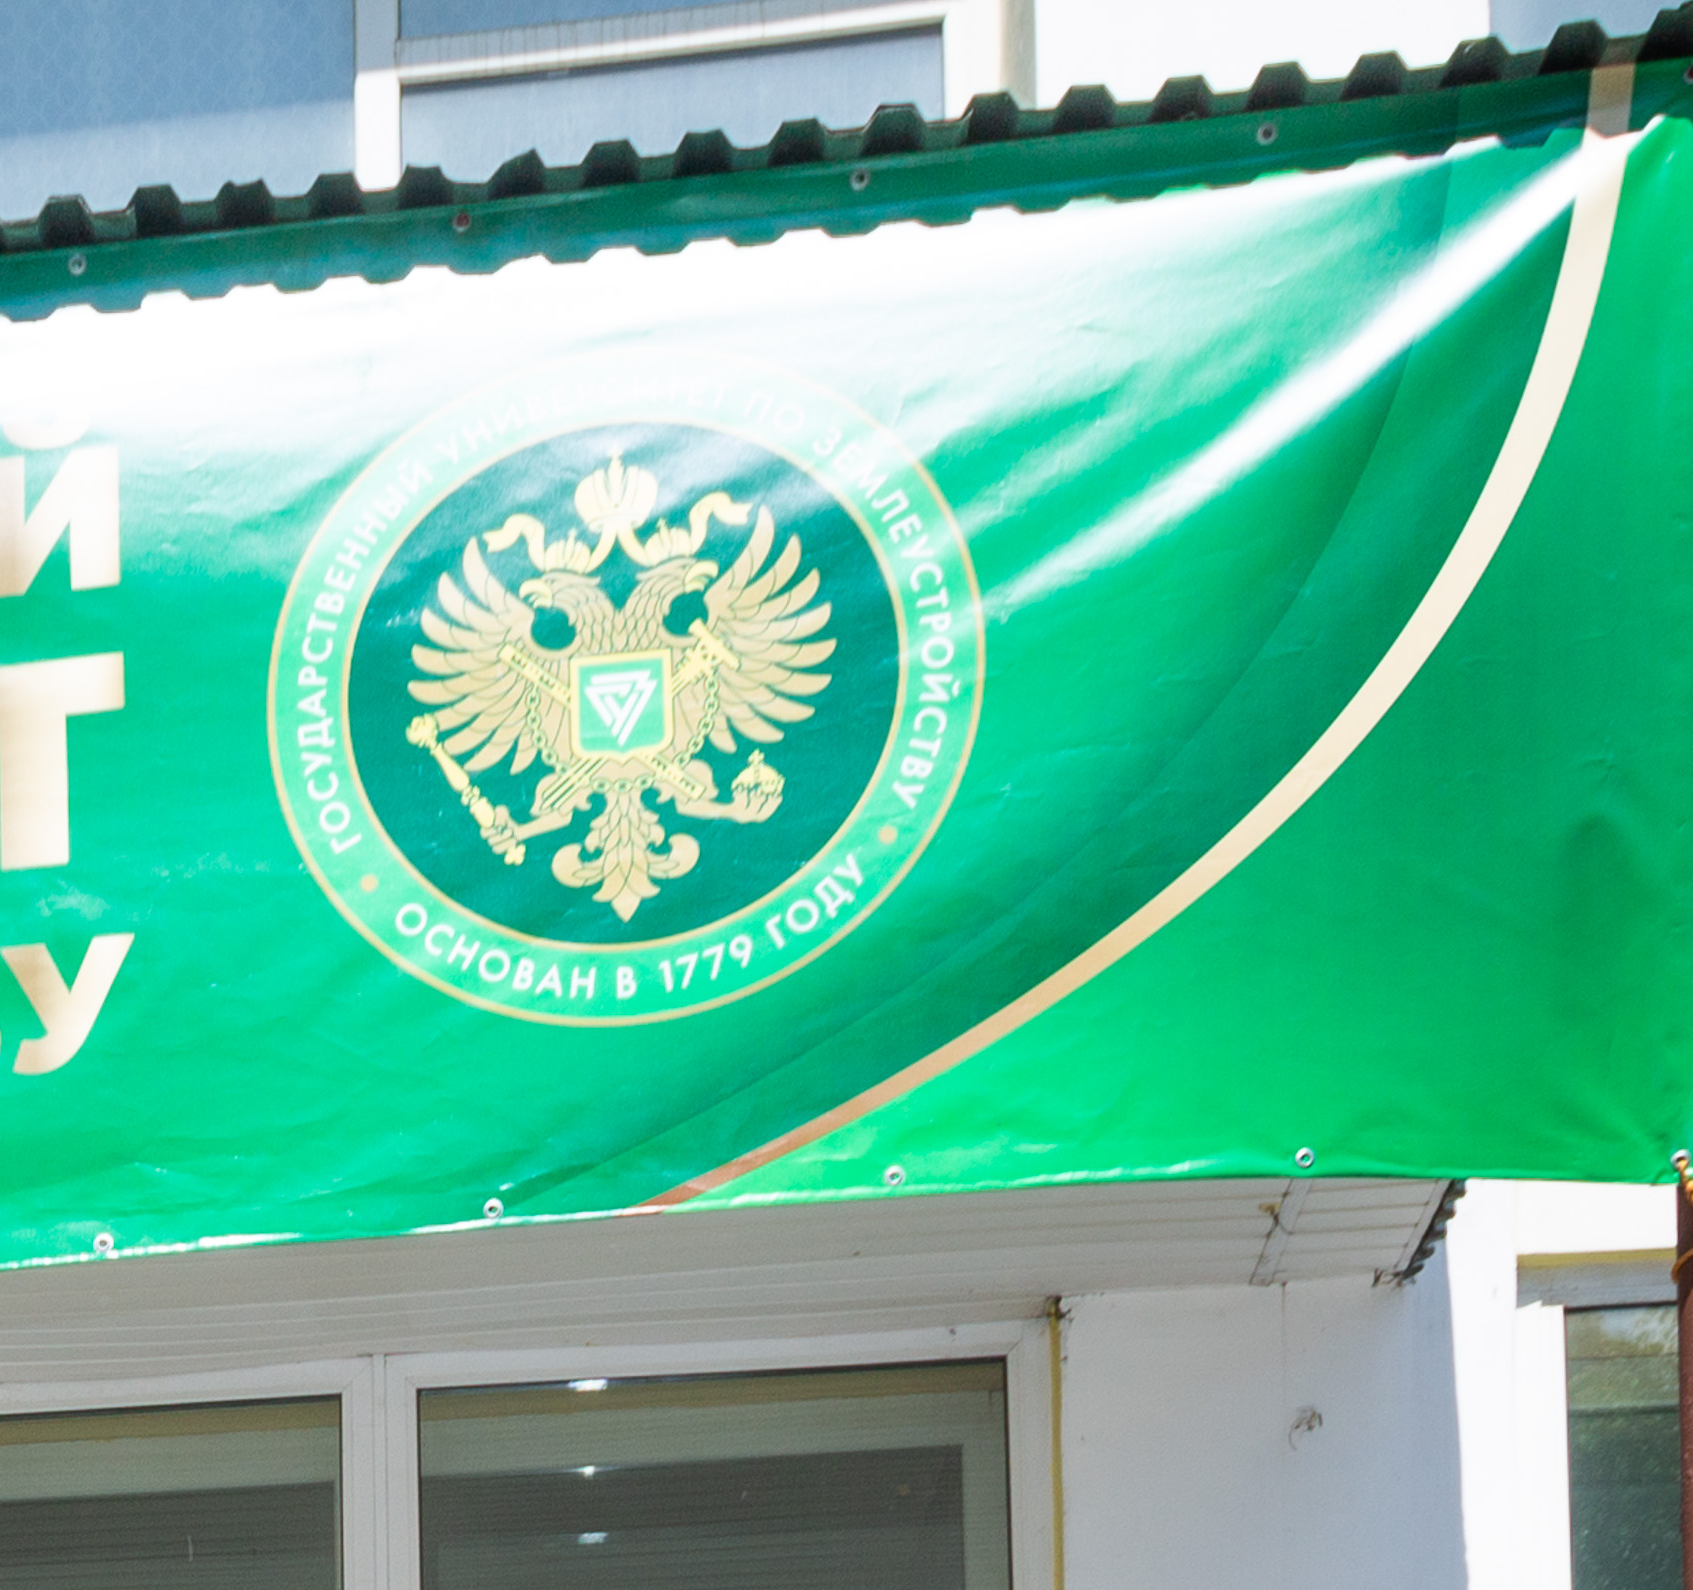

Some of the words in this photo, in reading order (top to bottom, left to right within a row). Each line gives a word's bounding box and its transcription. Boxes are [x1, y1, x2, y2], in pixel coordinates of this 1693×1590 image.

[393, 901, 598, 1000] ОСНОВАН
[615, 967, 640, 1000] В
[657, 934, 754, 995] 1779
[765, 852, 869, 952] ГОДУ
